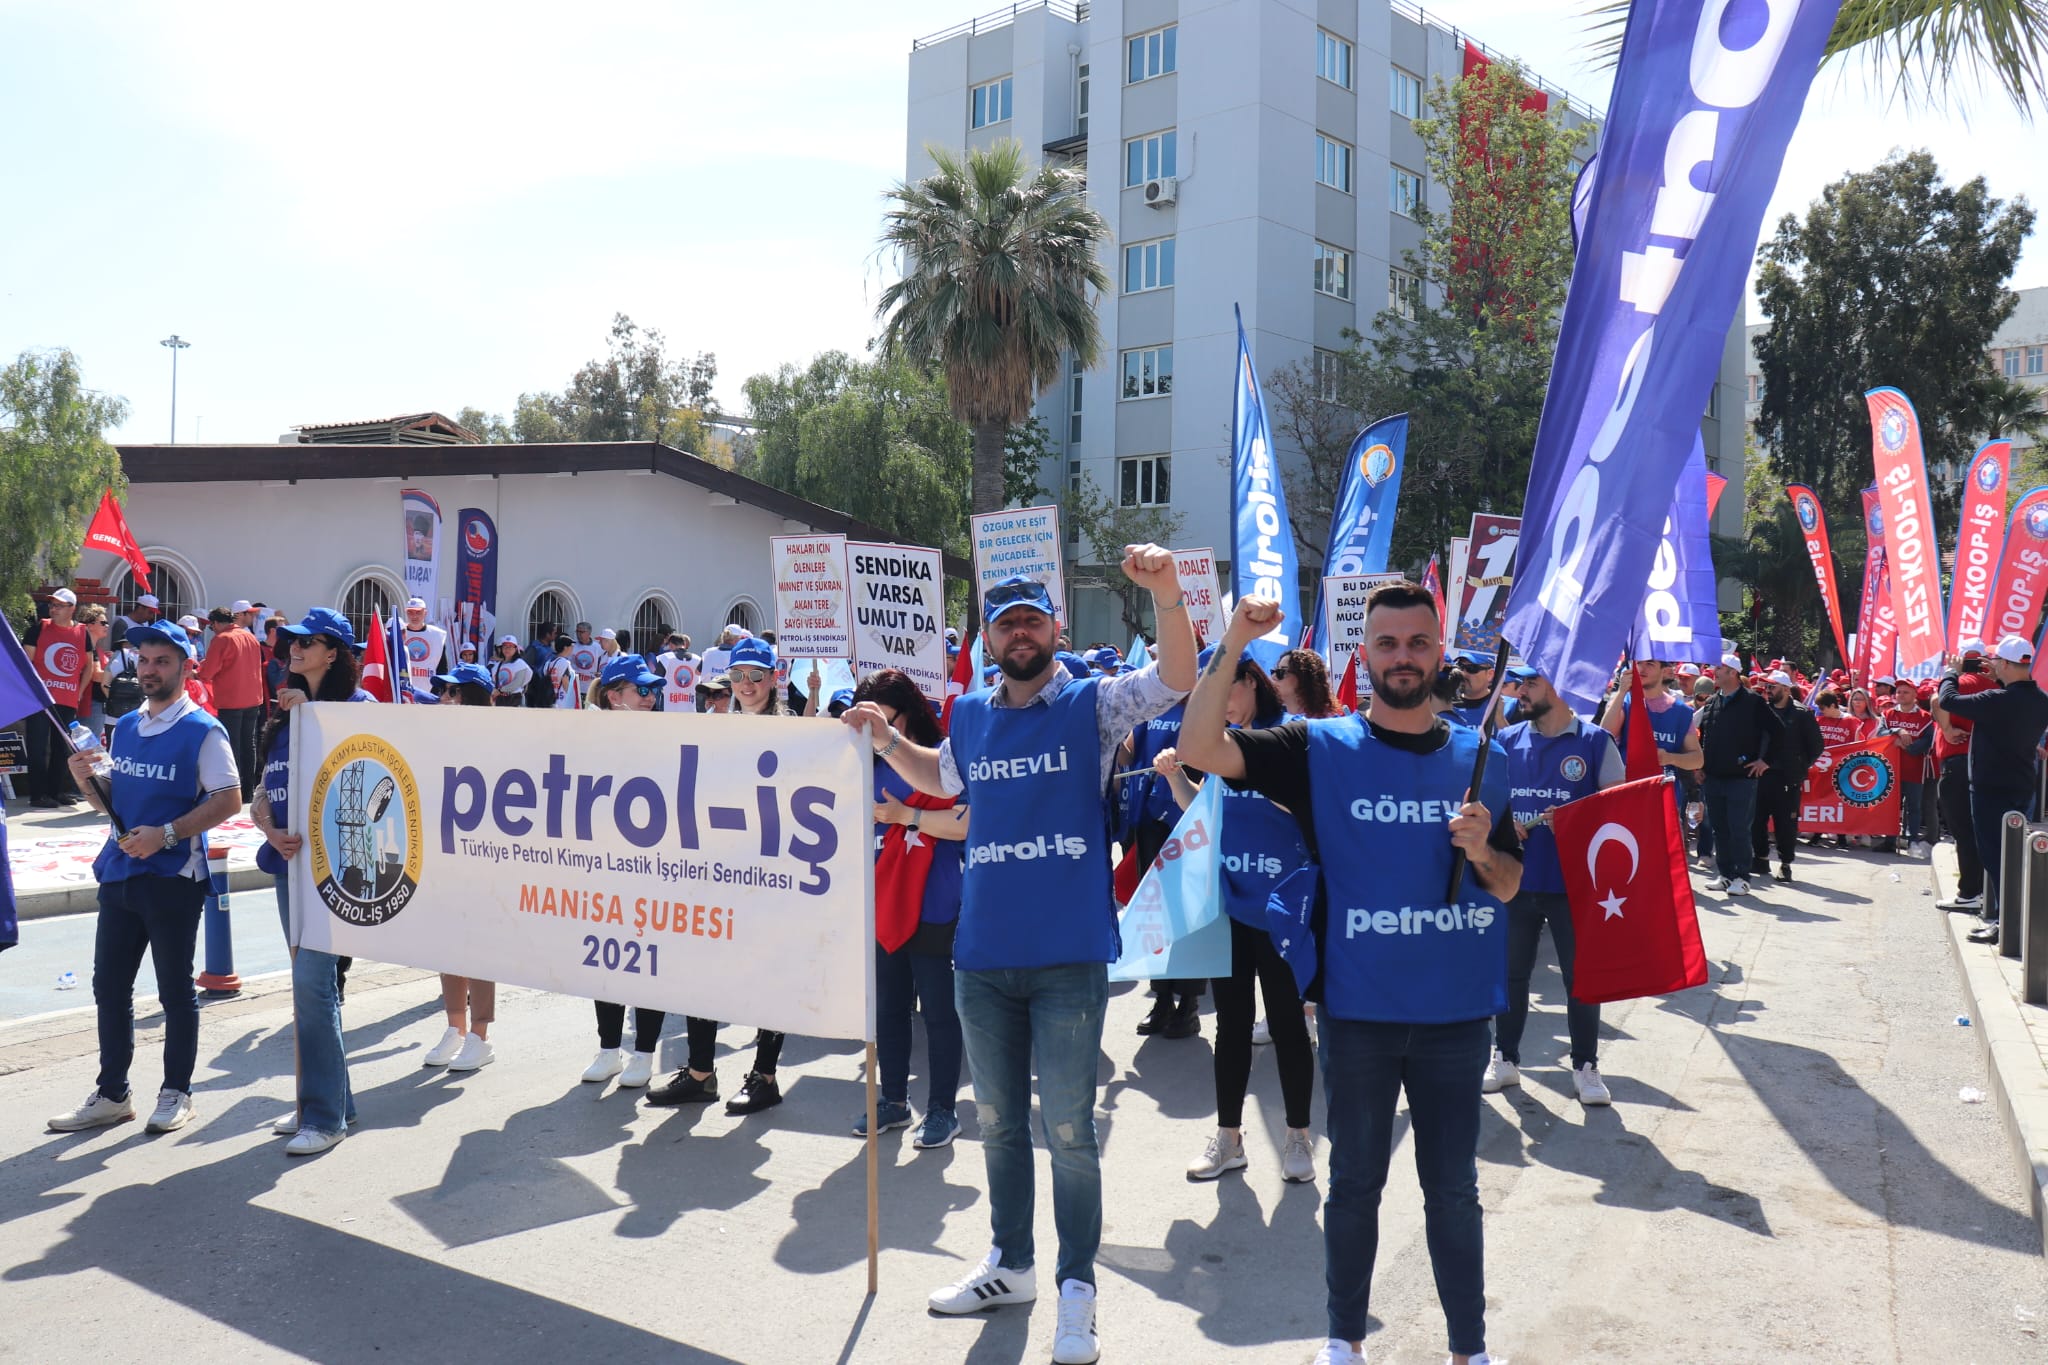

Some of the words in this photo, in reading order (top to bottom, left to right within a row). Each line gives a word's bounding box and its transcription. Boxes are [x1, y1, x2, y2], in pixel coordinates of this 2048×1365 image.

[982, 518, 1014, 532] ÖZGÜR
[1016, 519, 1026, 528] VE
[1030, 514, 1046, 526] EŞİT
[786, 542, 814, 554] HAKLARI
[816, 540, 830, 555] İÇİN
[979, 537, 992, 549] BİR
[996, 534, 1032, 546] GELECEK
[1034, 531, 1053, 544] İÇİN
[855, 554, 932, 581] SENDİKA
[982, 566, 1007, 580] ETKİN
[1179, 558, 1210, 576] ADALET
[805, 581, 814, 591] VE
[1343, 582, 1356, 591] BU
[1360, 581, 1380, 590] DAH
[1482, 576, 1504, 587] MAYIS
[794, 600, 812, 610] AKAN
[814, 600, 829, 610] TERE
[867, 582, 924, 606] VARSA
[784, 619, 803, 629] SAYGI
[805, 619, 813, 628] VE
[857, 606, 907, 630] UMUT
[913, 613, 936, 634] DA
[814, 632, 846, 642] SENDİKASI
[882, 634, 916, 656] VAR
[901, 668, 942, 680] SENDİKASI
[332, 745, 357, 767] KİMYA
[358, 742, 386, 756] LASTİK
[968, 746, 1068, 781] GÖREVLİ
[386, 752, 414, 798] İŞÇİLERİ
[313, 768, 332, 813] PETROL
[1511, 787, 1570, 800] petrol-iş
[440, 744, 838, 896] petrol-iş
[1351, 795, 1462, 823] GÖREV
[310, 814, 325, 872] TÜRKİYE
[407, 800, 418, 874] SENDİKASI
[968, 834, 1087, 869] petrol-iş
[460, 838, 508, 862] Türkiye
[513, 844, 554, 864] Petrol
[558, 847, 602, 872] Kimya
[607, 852, 652, 875] Lastik
[657, 852, 708, 882] İşçileri
[712, 862, 793, 890] Sendikası
[322, 882, 384, 924] PETROL-İŞ
[385, 883, 410, 915] 1950
[1346, 902, 1495, 939] petrol-iş
[582, 934, 658, 977] 2021
